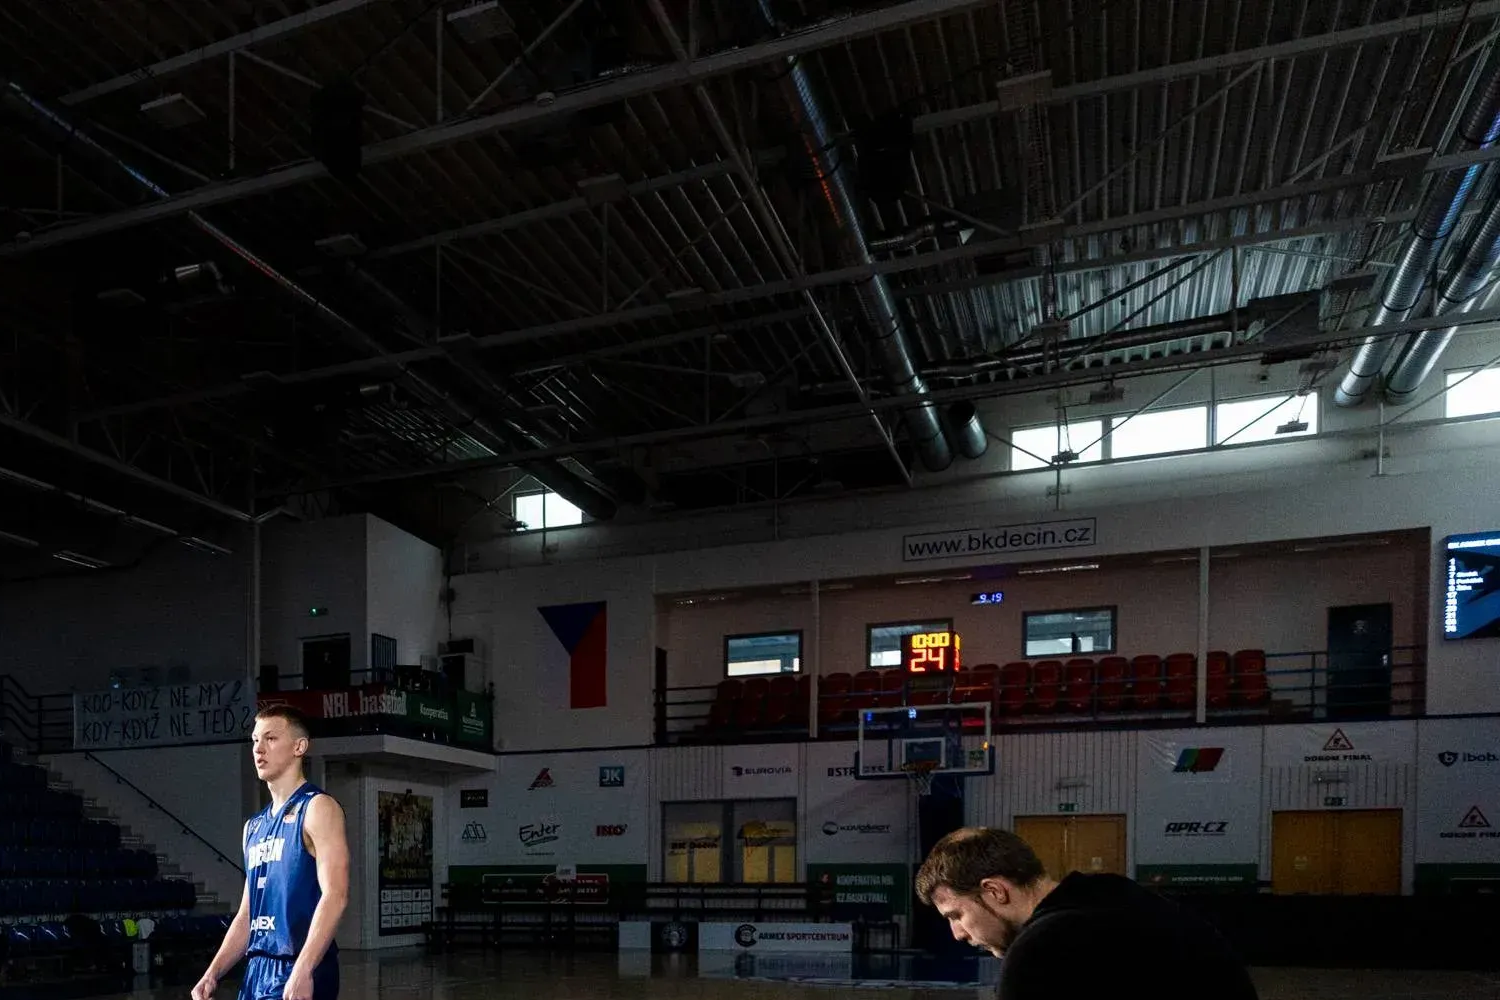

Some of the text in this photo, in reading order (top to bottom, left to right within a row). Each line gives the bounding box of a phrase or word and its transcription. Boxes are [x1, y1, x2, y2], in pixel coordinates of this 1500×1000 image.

[908, 527, 1091, 557] www.bkdecin.cz
[911, 632, 950, 649] 10:00
[910, 648, 945, 672] 24
[170, 686, 191, 708] NE
[199, 683, 226, 706] MY
[170, 712, 192, 737] NE
[602, 768, 622, 782] JK
[745, 766, 792, 775] EUROVIA
[518, 817, 561, 842] Enter
[1165, 821, 1228, 833] APR-CZ
[786, 932, 849, 941] SPORTCENTRUM
